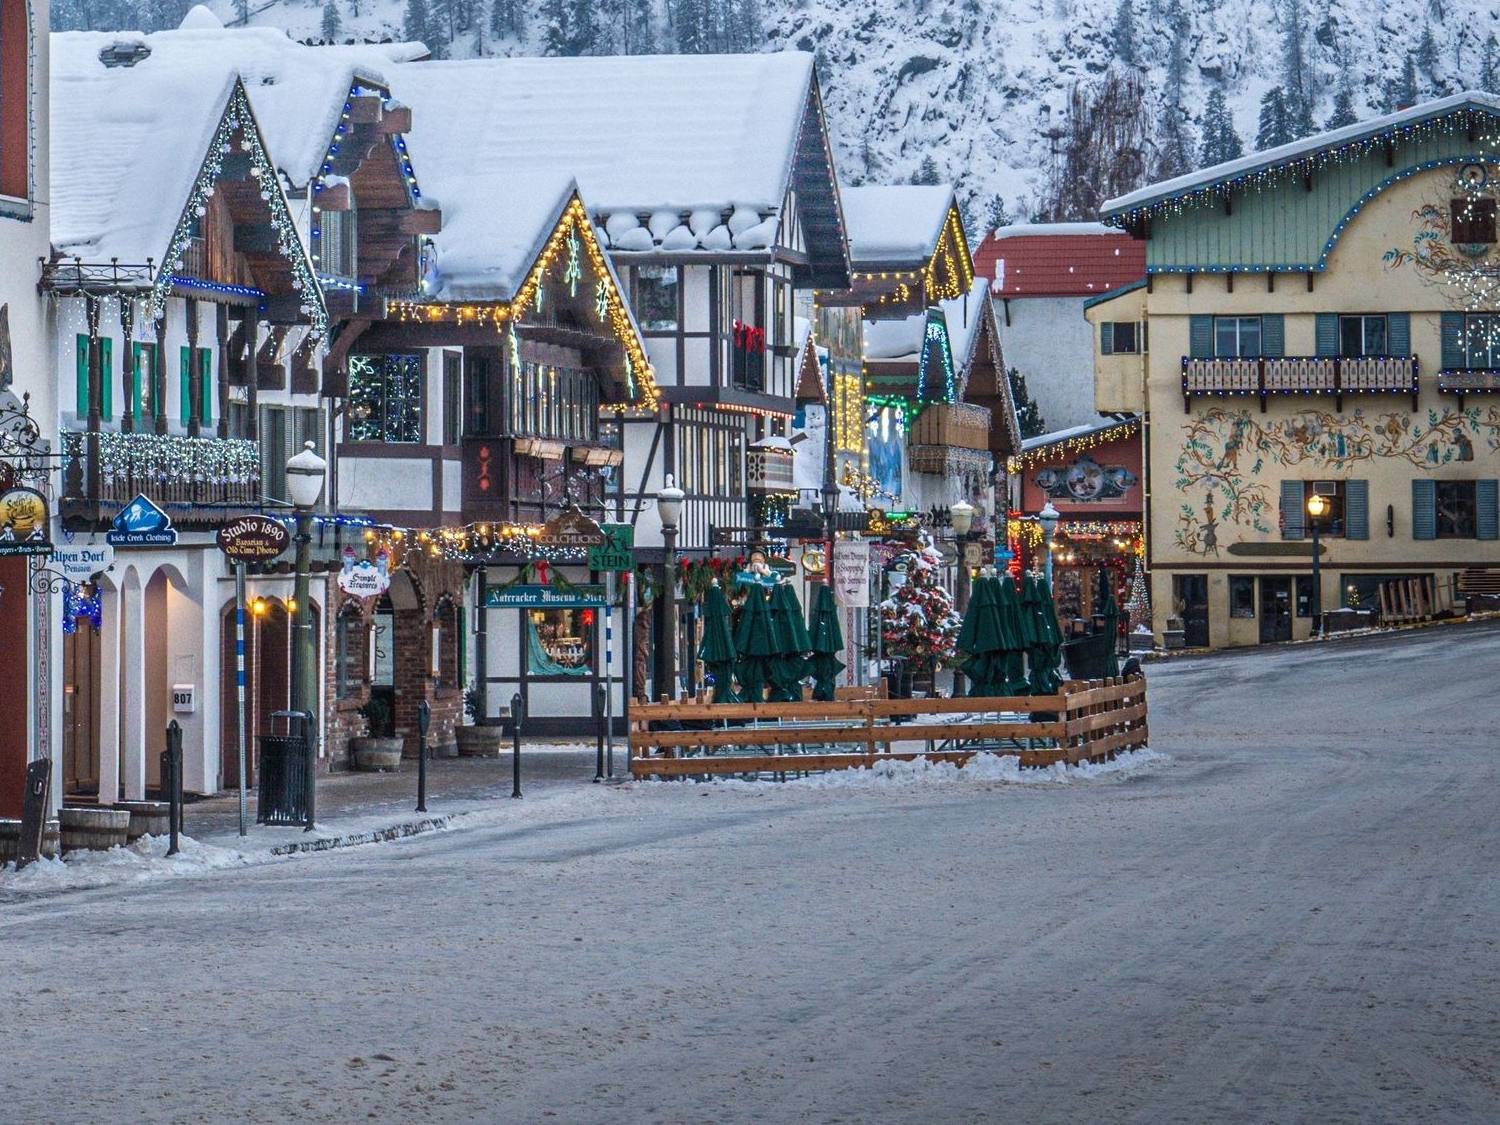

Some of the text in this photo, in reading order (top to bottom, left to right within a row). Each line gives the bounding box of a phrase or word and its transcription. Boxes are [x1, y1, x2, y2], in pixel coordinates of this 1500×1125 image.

[221, 518, 284, 543] Studio 1890
[111, 533, 171, 543] Icicle Creek Clothing
[225, 545, 279, 555] Old Time Photos
[49, 550, 106, 565] Alpen Dorf
[591, 555, 630, 567] STEIN
[63, 563, 91, 573] Pension
[352, 573, 377, 582] Simple
[491, 590, 537, 603] Nutcracker
[541, 589, 576, 603] Museum
[174, 693, 192, 704] 807
